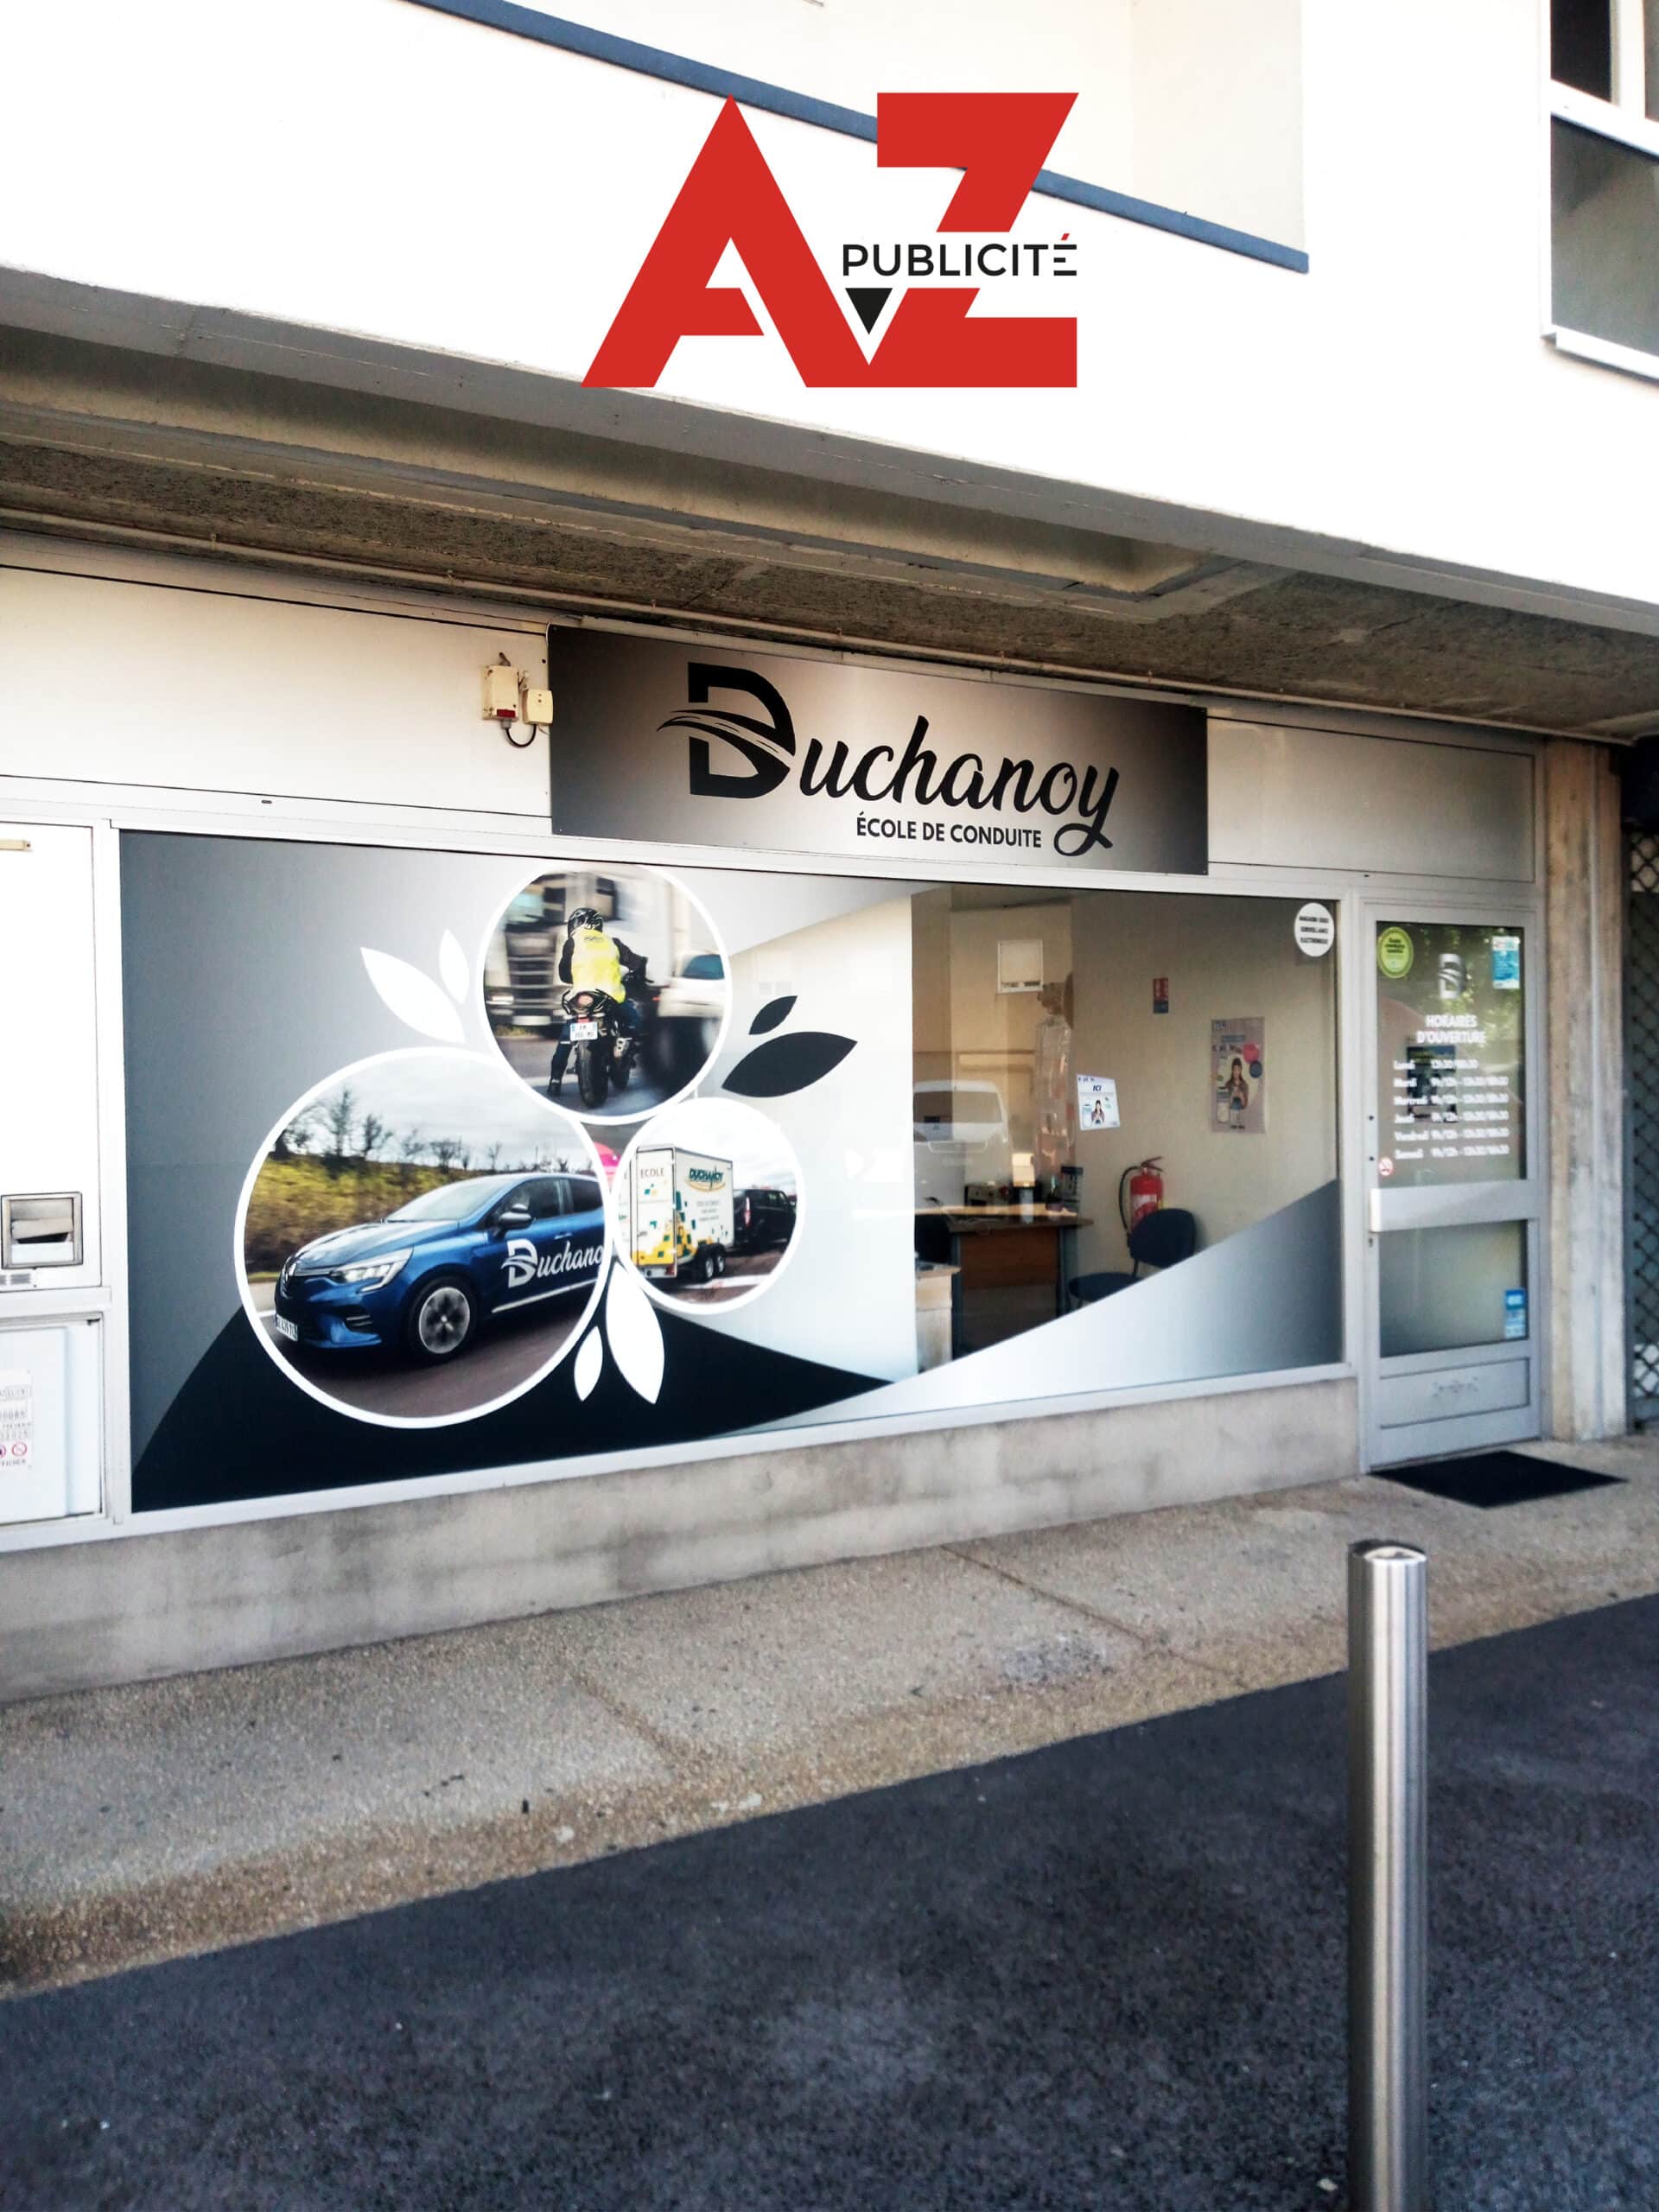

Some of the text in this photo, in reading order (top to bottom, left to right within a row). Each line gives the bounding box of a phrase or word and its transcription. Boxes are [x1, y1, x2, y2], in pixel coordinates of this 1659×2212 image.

[657, 662, 1120, 856] Duchanoy
[856, 810, 1042, 849] ÉCOLE DE CONDUITE
[1425, 1014, 1478, 1028] HORAIRES
[1416, 1030, 1487, 1044] D'OUVERTURE
[640, 1168, 664, 1178] ECOLE
